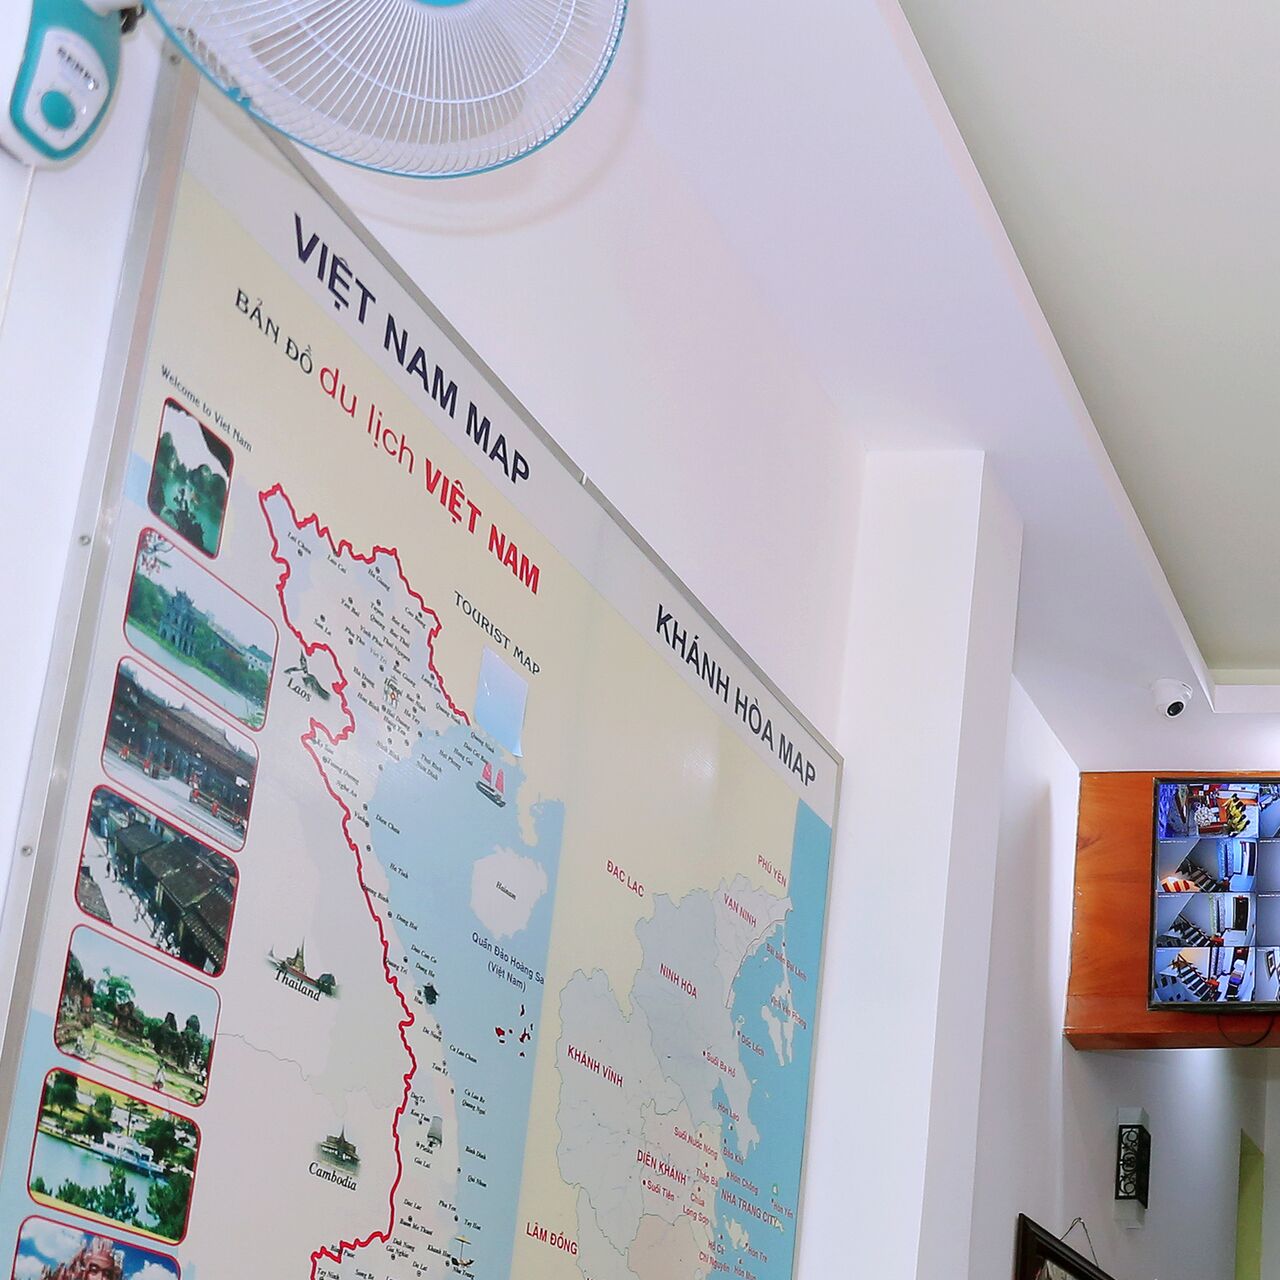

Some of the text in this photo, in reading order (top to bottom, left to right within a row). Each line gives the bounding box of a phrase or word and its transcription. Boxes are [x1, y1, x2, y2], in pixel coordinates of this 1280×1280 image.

[293, 212, 530, 485] VIỆT NAM MAP
[161, 364, 201, 409] Welcome
[202, 402, 212, 417] to
[235, 288, 280, 344] BẢN
[320, 366, 358, 418] du
[367, 403, 415, 474] lịch
[425, 457, 482, 534] VIỆT
[488, 523, 540, 595] NAM
[454, 590, 541, 675] TOURIST MAP
[287, 677, 312, 702] Laos
[656, 603, 816, 787] KHÁNH HÒA MAP
[274, 967, 321, 1002] Thailand
[507, 972, 527, 993] Nam)
[535, 971, 545, 985] Sa
[659, 963, 680, 986] NINH
[567, 1044, 600, 1074] KHÁNH
[308, 1161, 357, 1192] Cambodia
[721, 1189, 737, 1208] NHA
[737, 1196, 761, 1220] TRANG
[526, 1222, 548, 1244] LÂM
